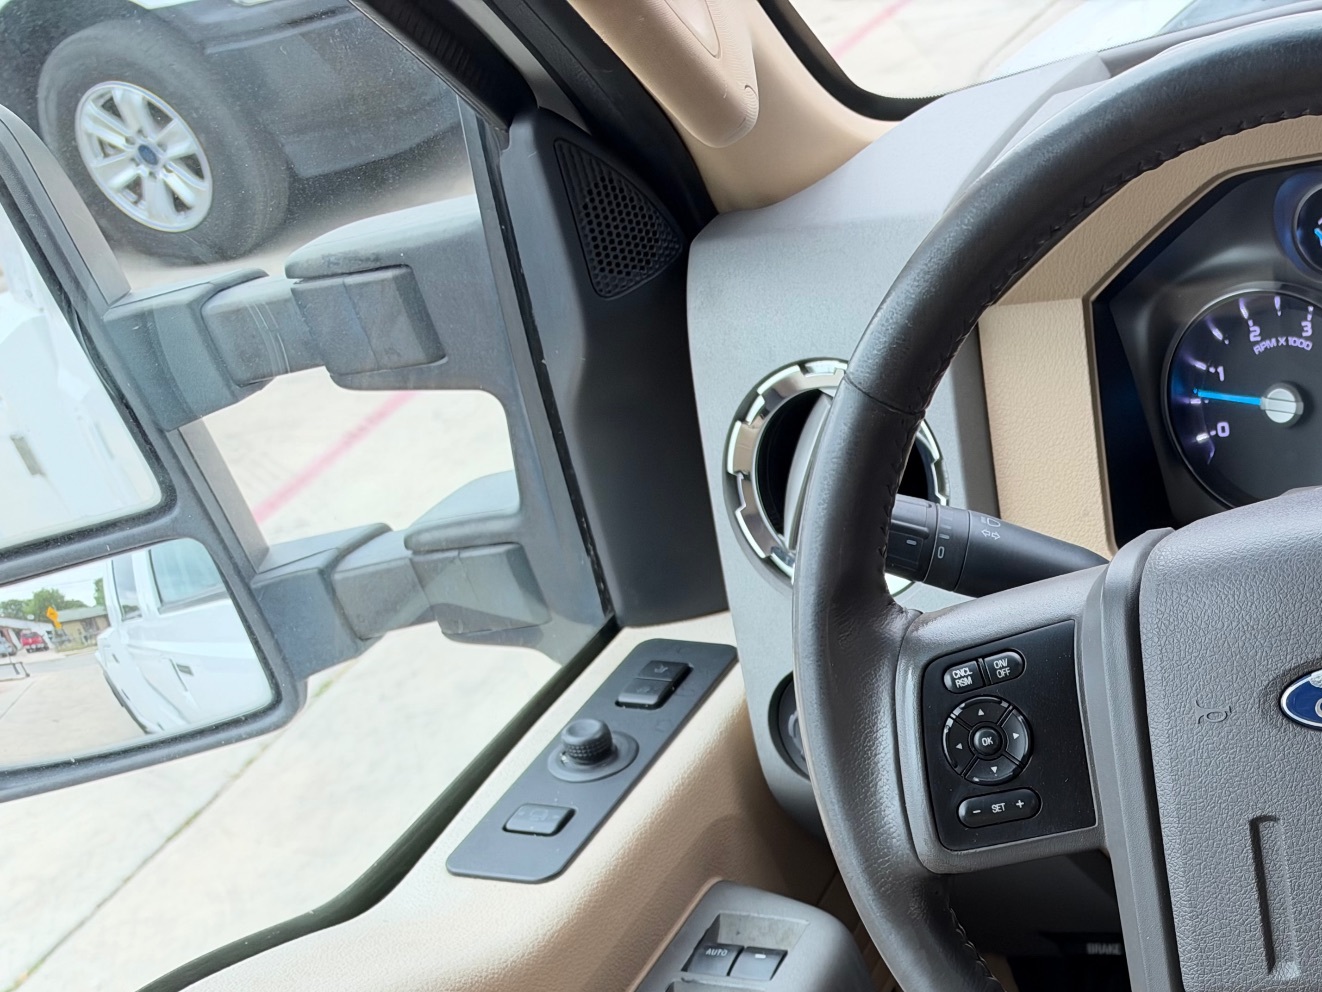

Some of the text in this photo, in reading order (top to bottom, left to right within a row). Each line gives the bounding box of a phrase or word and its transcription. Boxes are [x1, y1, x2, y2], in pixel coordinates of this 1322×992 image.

[1250, 326, 1262, 341] 2
[1302, 321, 1312, 336] 3
[1253, 337, 1276, 355] RPM
[1288, 336, 1312, 350] 1000
[1217, 366, 1224, 381] 1
[1217, 422, 1230, 437] 0
[994, 658, 1008, 668] ON/
[952, 667, 973, 678] CNCL
[997, 667, 1011, 678] OFF
[955, 676, 972, 688] RSM
[982, 736, 993, 746] OK
[992, 803, 1006, 813] SET
[705, 948, 728, 957] AUTO
